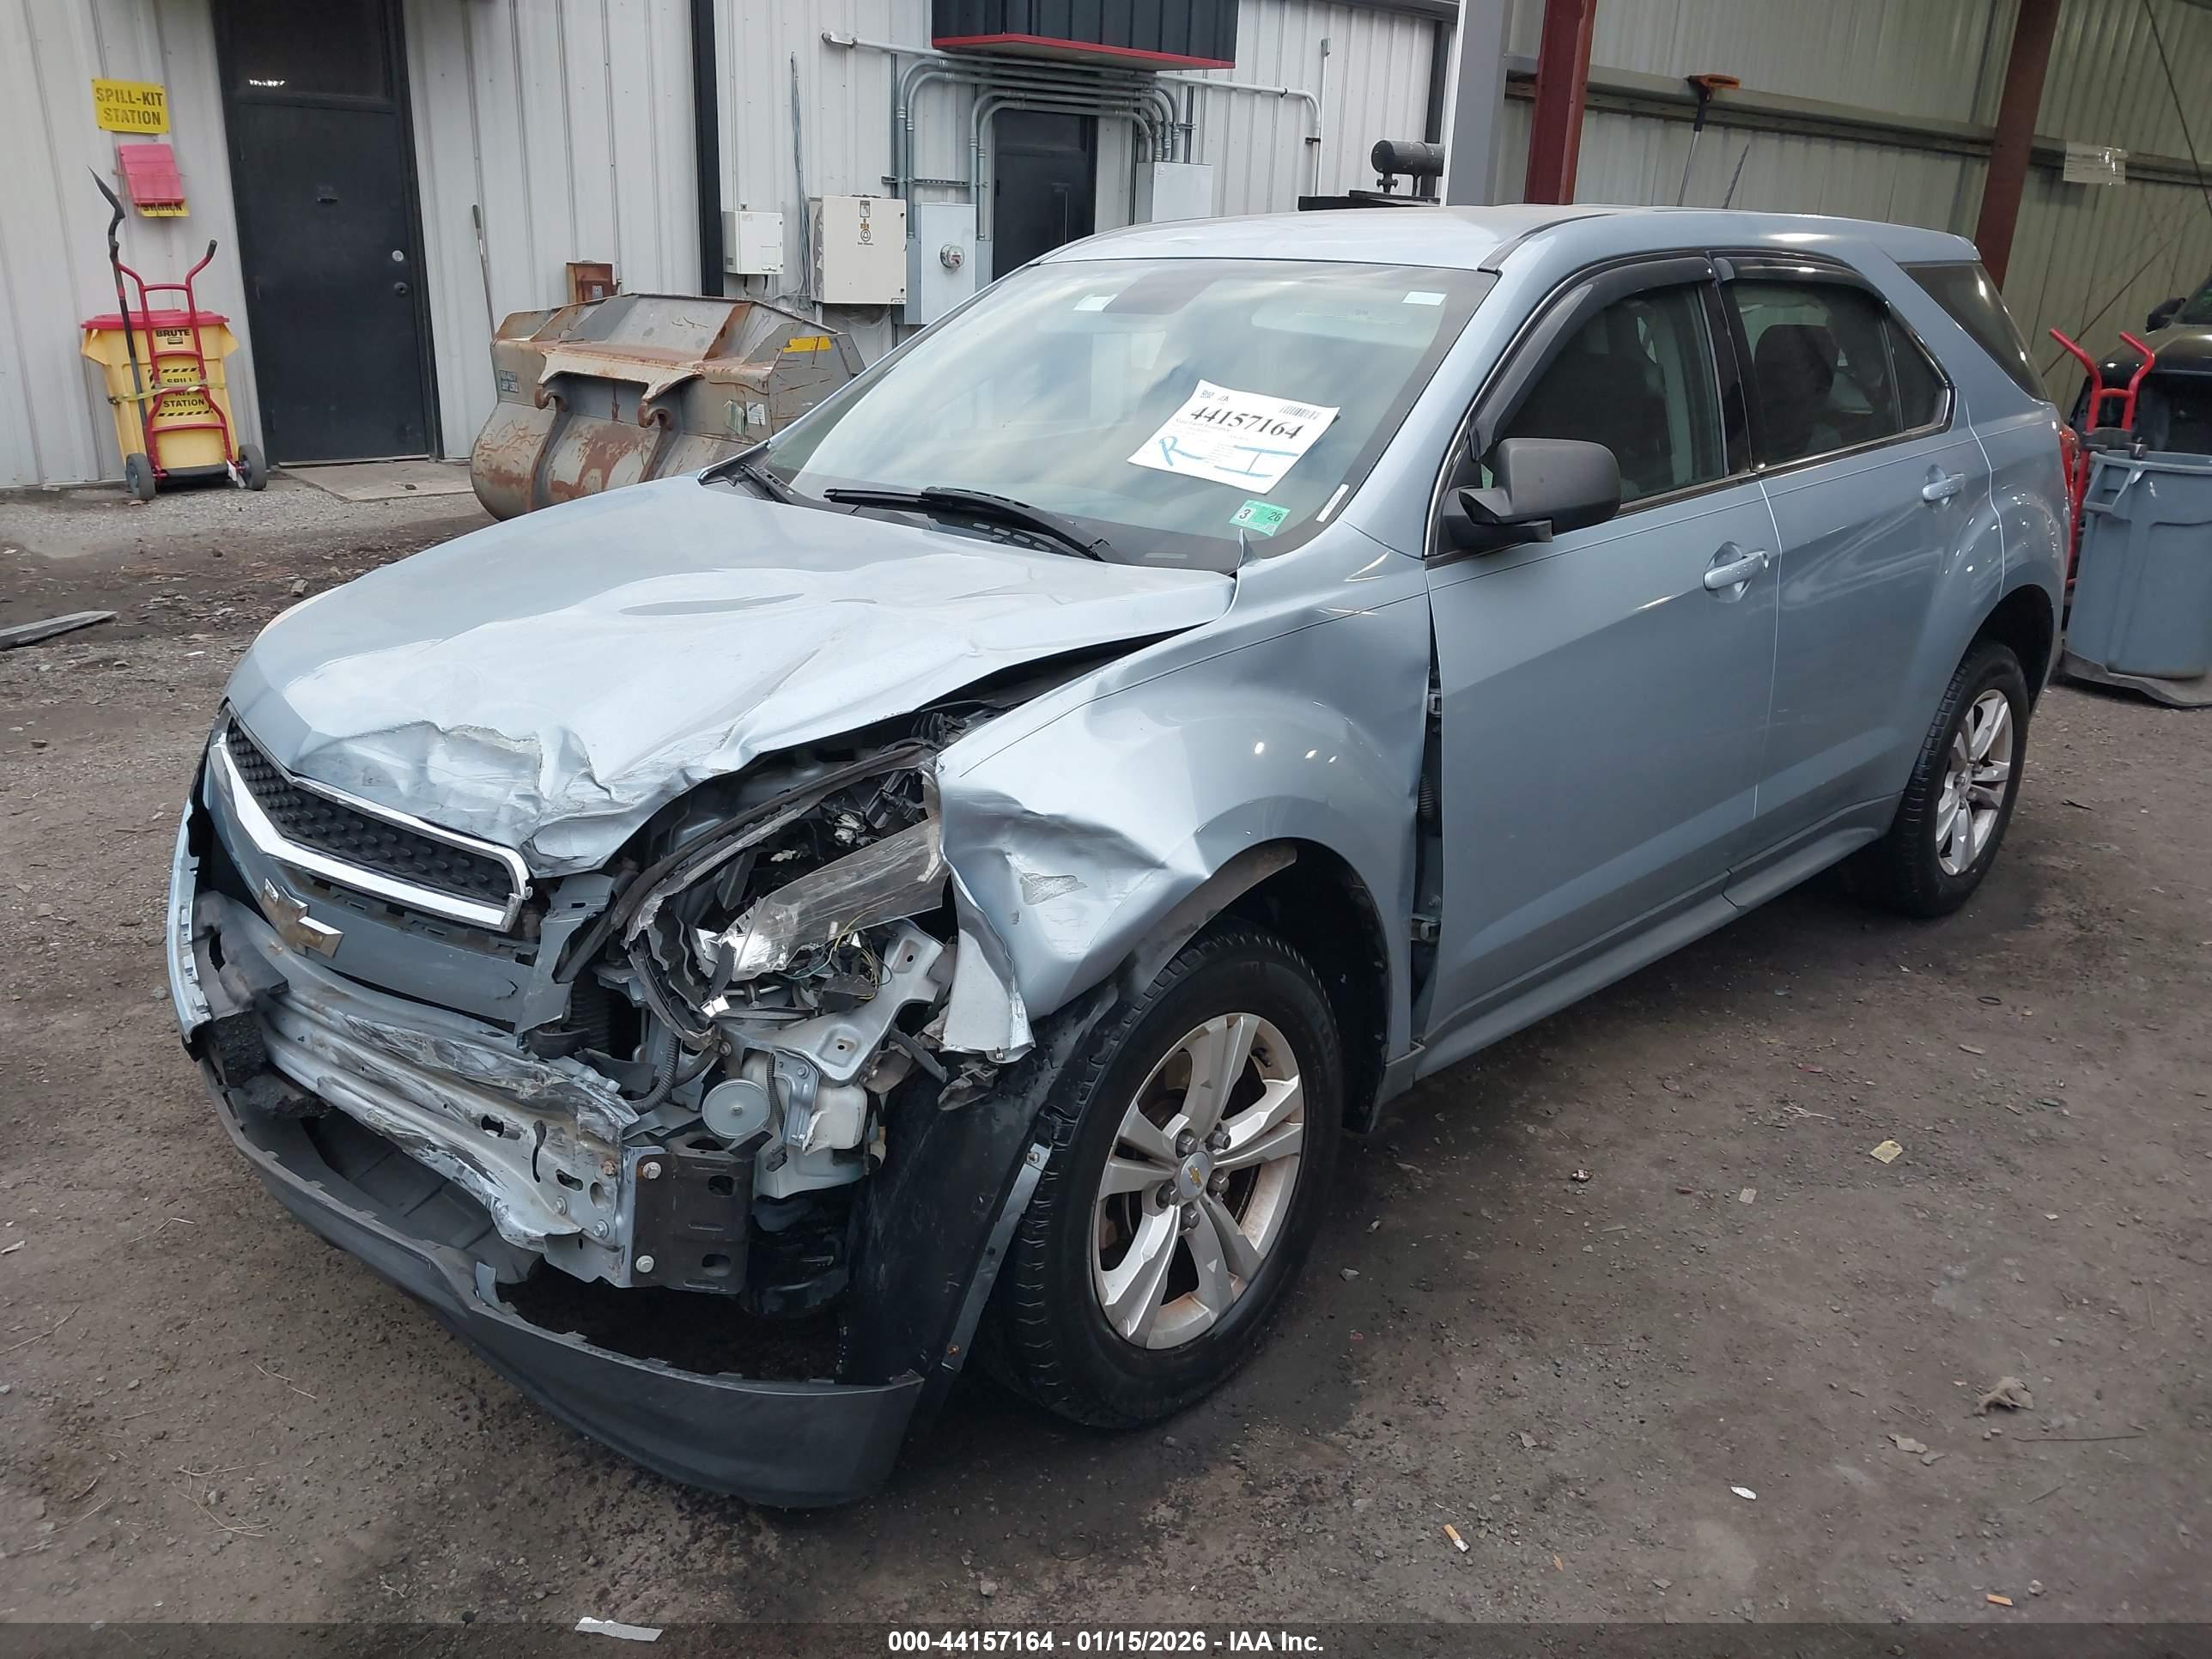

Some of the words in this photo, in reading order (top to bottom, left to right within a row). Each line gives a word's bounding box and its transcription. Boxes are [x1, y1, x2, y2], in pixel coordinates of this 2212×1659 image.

[95, 87, 164, 106] SPILL-KIT
[104, 107, 161, 125] STATION
[155, 329, 191, 337] BRUTE
[163, 398, 205, 408] STATION
[1190, 406, 1304, 440] 44157164
[1239, 508, 1251, 520] 3
[1267, 511, 1284, 522] 26
